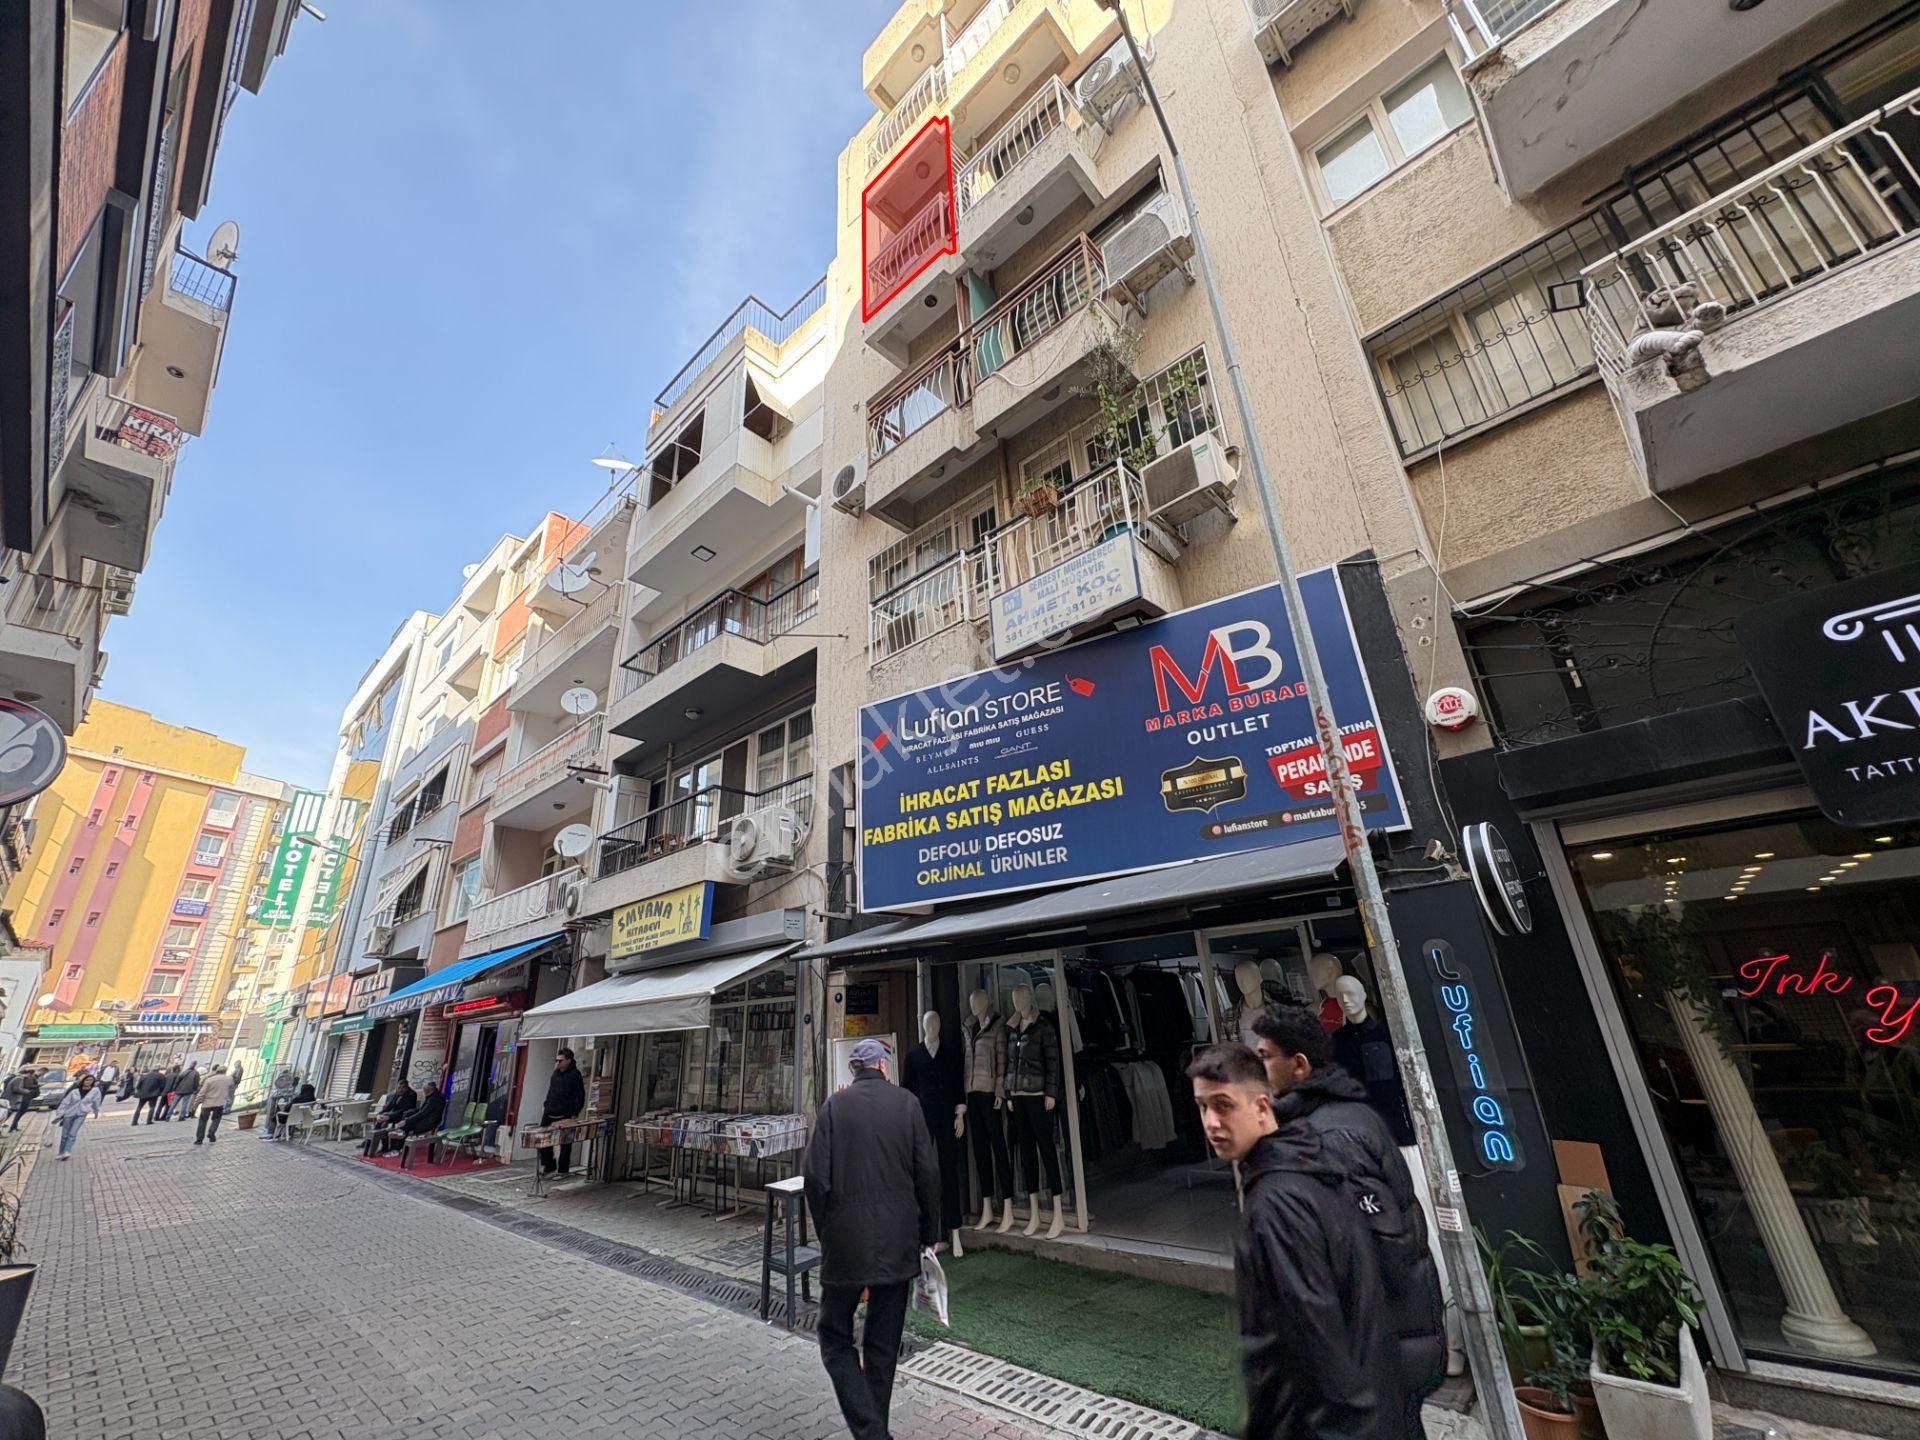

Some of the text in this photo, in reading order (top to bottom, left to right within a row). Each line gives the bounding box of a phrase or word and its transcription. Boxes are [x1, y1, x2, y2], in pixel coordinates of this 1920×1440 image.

[1028, 568, 1062, 592] SERBEST
[1005, 590, 1070, 631] AHMET
[901, 681, 1063, 741] Lufian STORE
[933, 731, 963, 747] FAZLASI
[963, 722, 997, 739] FABRİKA
[998, 717, 1020, 730] SATIŞ
[1022, 704, 1065, 723] MAĞAZASI
[1145, 681, 1309, 732] MARKA BURAD
[1015, 723, 1050, 738] GUESS
[1187, 713, 1271, 745] OUTLET
[1265, 736, 1314, 756] TOPTAN
[915, 746, 958, 764] BEYMEN
[927, 755, 980, 775] ALLSAINTS
[1277, 739, 1376, 783] PERANDE
[1845, 755, 1920, 783] TATT
[899, 758, 1071, 814] İHRACAT FAZLASI
[1303, 773, 1364, 796] SAŞ
[863, 776, 1124, 847] FABRİKA SATIŞ MAĞAZASI
[1223, 818, 1268, 834] lufianstore
[918, 823, 1064, 864] DEFOLU DEFOSUZ
[274, 834, 305, 906] HOTEL
[916, 846, 1069, 886] ORJİNAL ÜRÜNLER
[1739, 953, 1854, 997] Ink
[1432, 948, 1514, 1162] Lufian
